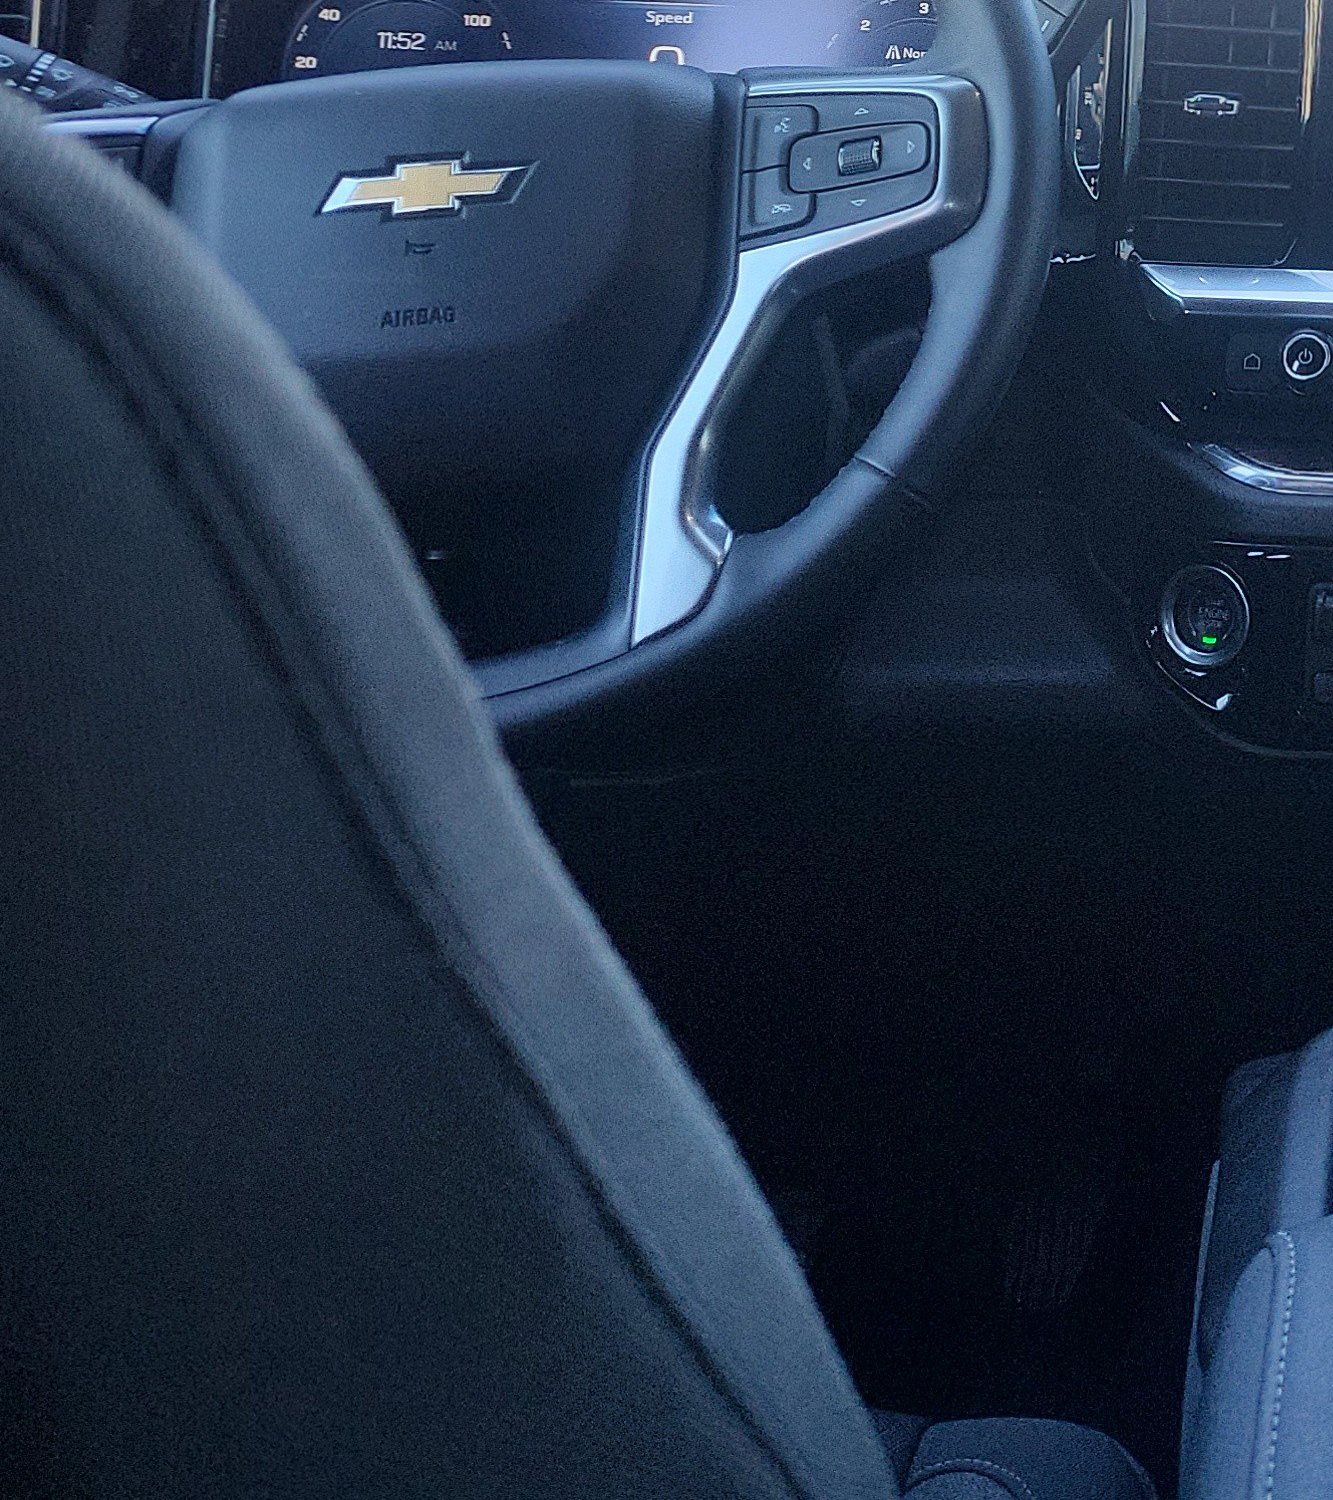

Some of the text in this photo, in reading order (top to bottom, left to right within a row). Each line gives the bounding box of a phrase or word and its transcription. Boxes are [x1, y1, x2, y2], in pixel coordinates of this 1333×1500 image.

[318, 8, 341, 22] 40
[918, 2, 930, 16] 3
[463, 13, 492, 27] 100
[645, 9, 694, 26] Speed
[859, 19, 871, 32] 2
[376, 31, 458, 51] 11:52 AM
[294, 55, 317, 69] 20
[380, 306, 456, 329] AIRBAG
